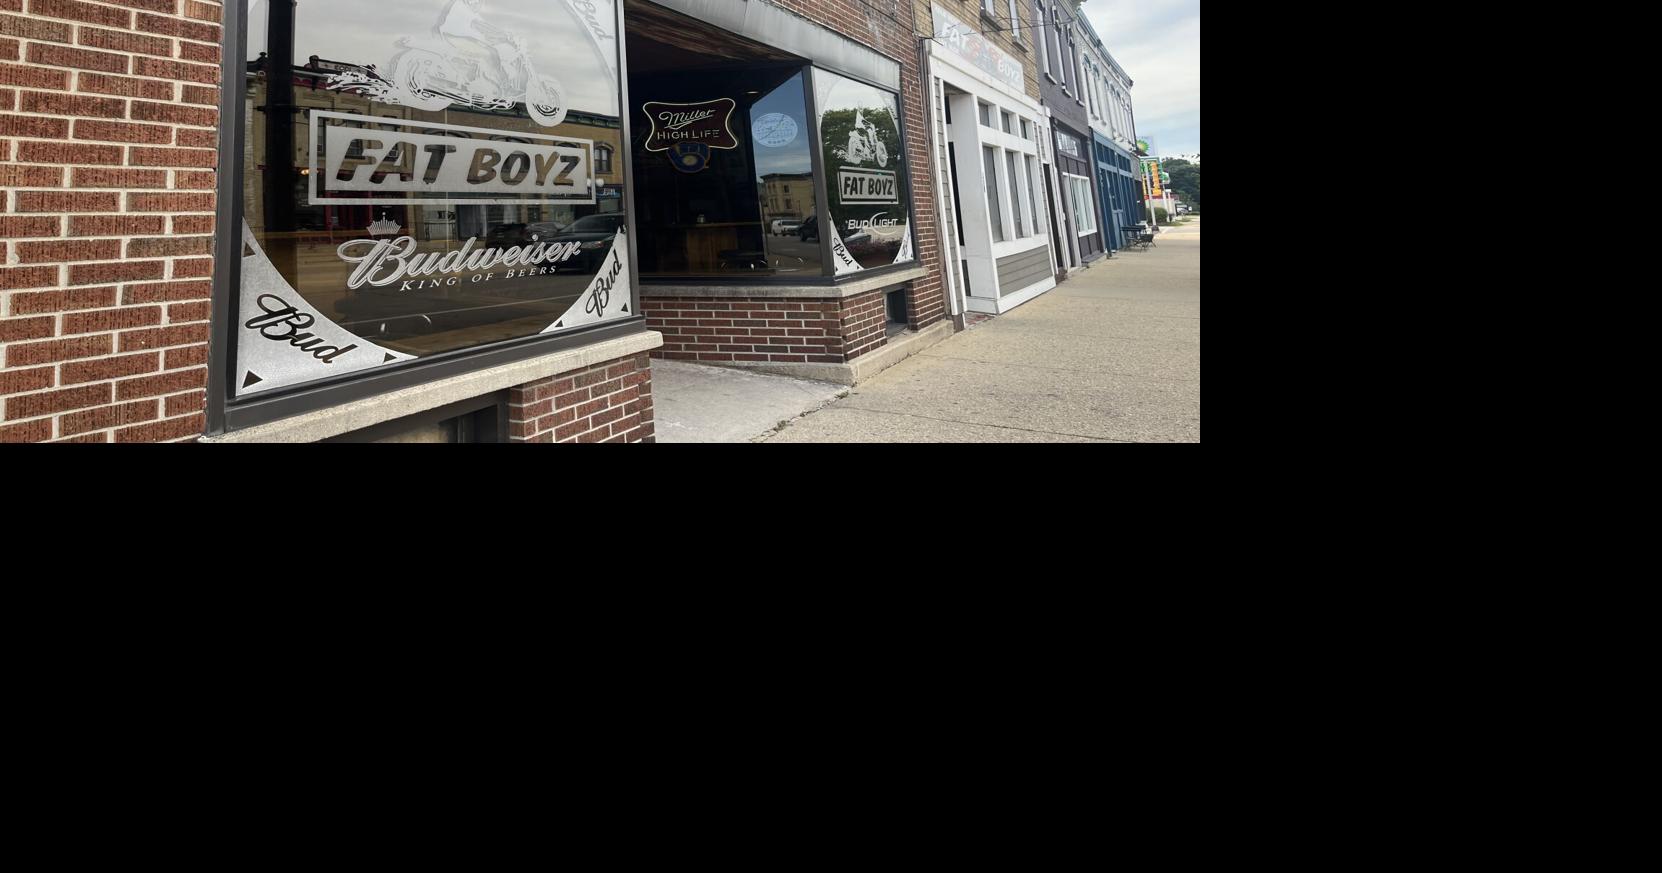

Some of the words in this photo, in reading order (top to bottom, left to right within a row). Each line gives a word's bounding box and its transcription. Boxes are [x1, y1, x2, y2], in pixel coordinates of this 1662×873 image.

[941, 22, 969, 50] FAT
[658, 109, 717, 130] Miller
[657, 131, 689, 140] HIGH
[692, 129, 720, 139] LIFE
[336, 138, 456, 185] FAT
[466, 146, 581, 187] BOYZ
[843, 176, 866, 196] FAT
[867, 178, 894, 196] BOYZ
[847, 219, 869, 230] BUD
[873, 218, 899, 228] LIGHT
[336, 233, 582, 290] Budweiser
[832, 237, 853, 268] Bud
[400, 276, 457, 292] KING
[471, 272, 495, 283] OF
[505, 265, 557, 279] BEERS
[585, 248, 623, 318] Bud
[244, 293, 358, 365] Bud
